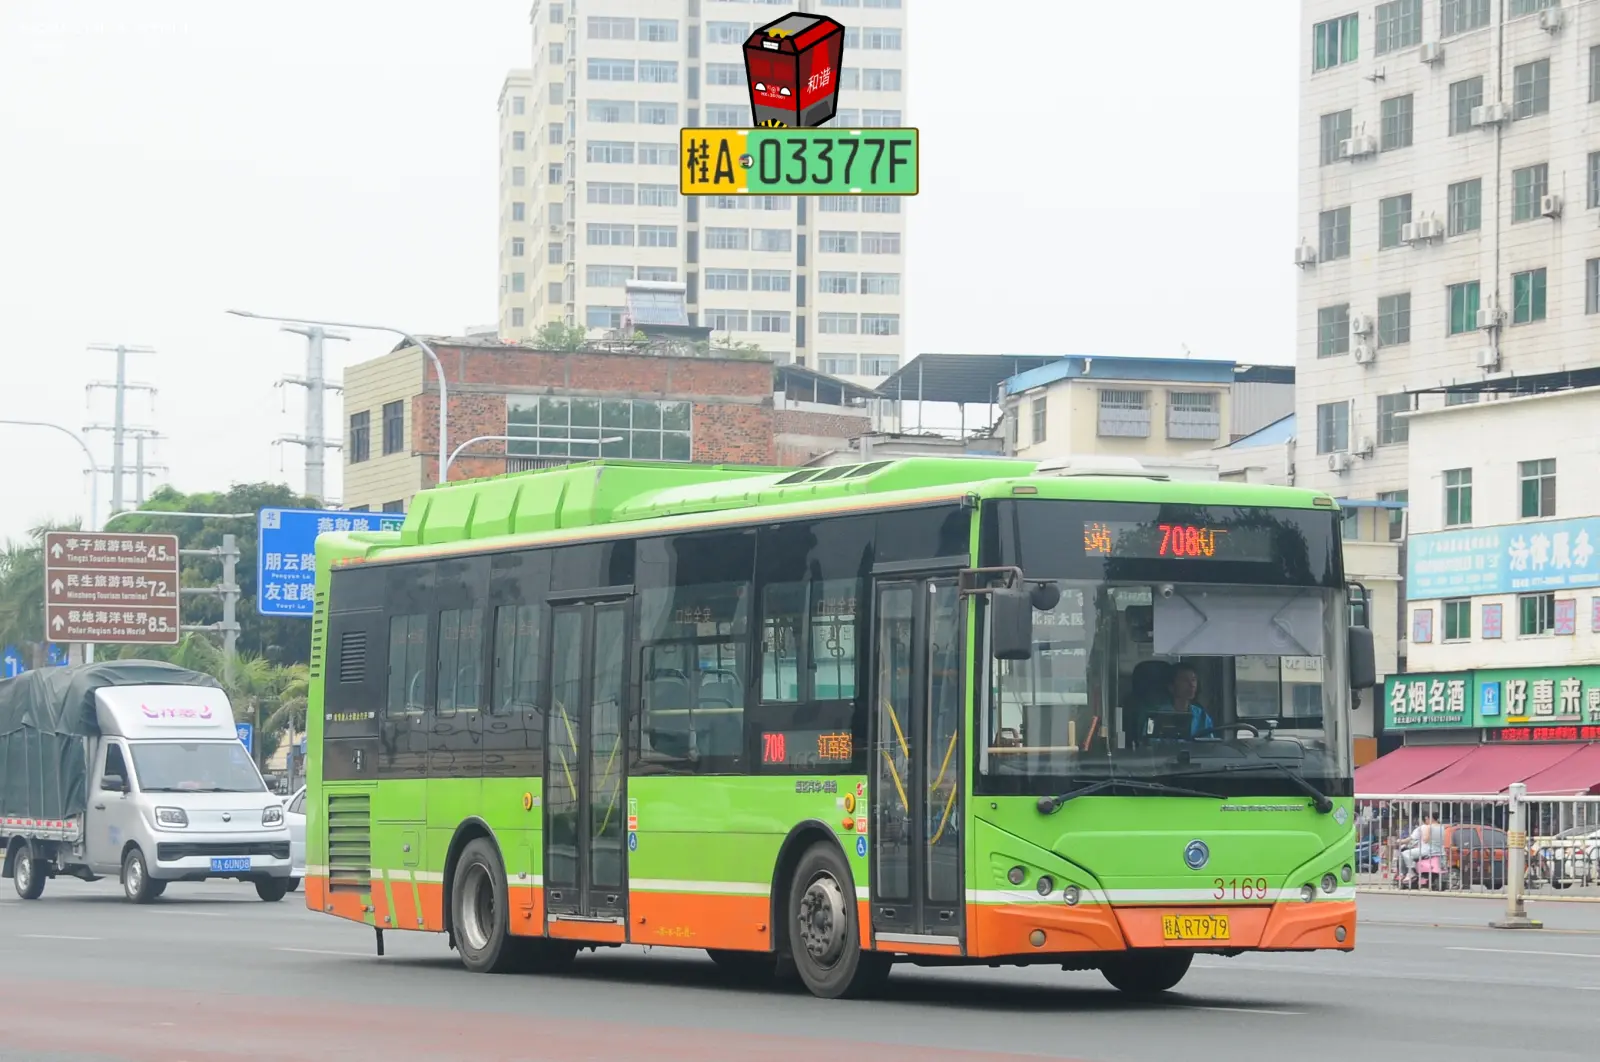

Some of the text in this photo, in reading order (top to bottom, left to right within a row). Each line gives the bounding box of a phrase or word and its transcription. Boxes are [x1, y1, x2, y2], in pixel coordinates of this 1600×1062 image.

[66, 538, 147, 552] 亭子旅游码头
[1159, 525, 1199, 556] 708
[1508, 527, 1594, 571] 法律服务
[90, 554, 117, 563] Tourism
[118, 555, 147, 564] terminal
[265, 553, 316, 571] 朋云路
[67, 574, 148, 588] 民生旅游码头
[97, 592, 121, 600] Tourism
[121, 592, 148, 600] terminal
[264, 582, 315, 601] 友谊路
[68, 611, 148, 624] 极地海洋世界
[68, 627, 86, 635] Polar
[87, 627, 111, 636] Region
[1390, 679, 1465, 713] 名烟名酒
[1505, 677, 1581, 715] 好惠来
[764, 734, 785, 762] 708
[1213, 877, 1267, 899] 3169
